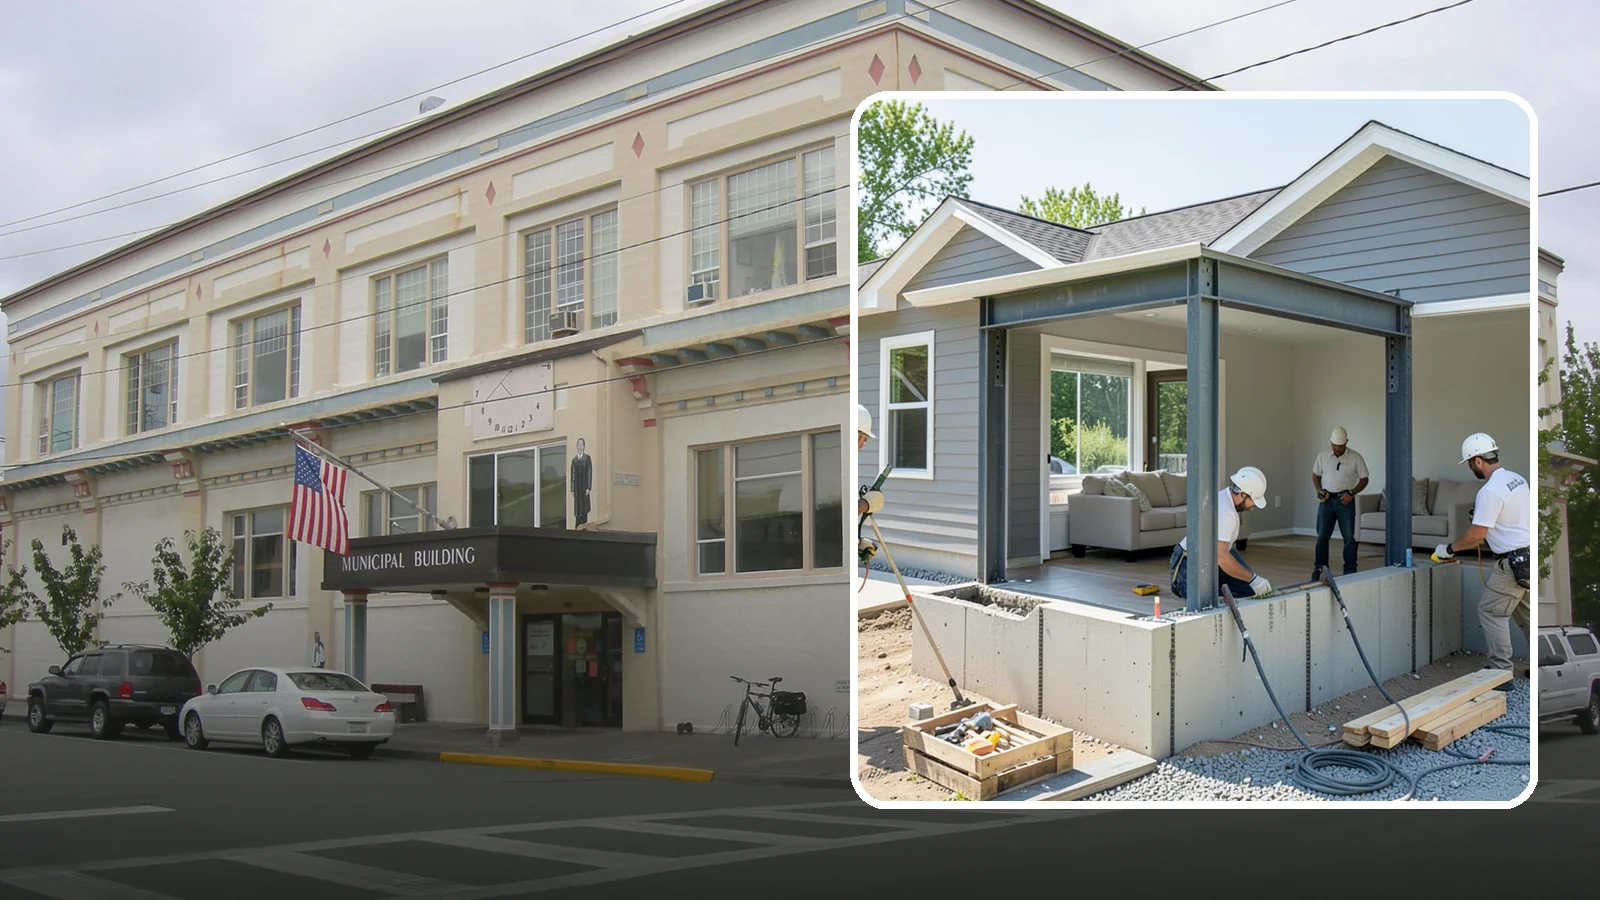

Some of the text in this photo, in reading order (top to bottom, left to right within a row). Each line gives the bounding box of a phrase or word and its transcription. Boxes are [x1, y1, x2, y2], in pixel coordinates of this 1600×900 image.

[547, 362, 552, 370] 6
[475, 390, 479, 398] 7
[481, 407, 484, 415] 8
[529, 414, 533, 422] 3
[342, 546, 475, 572] MUNICIPAL BUILDING
